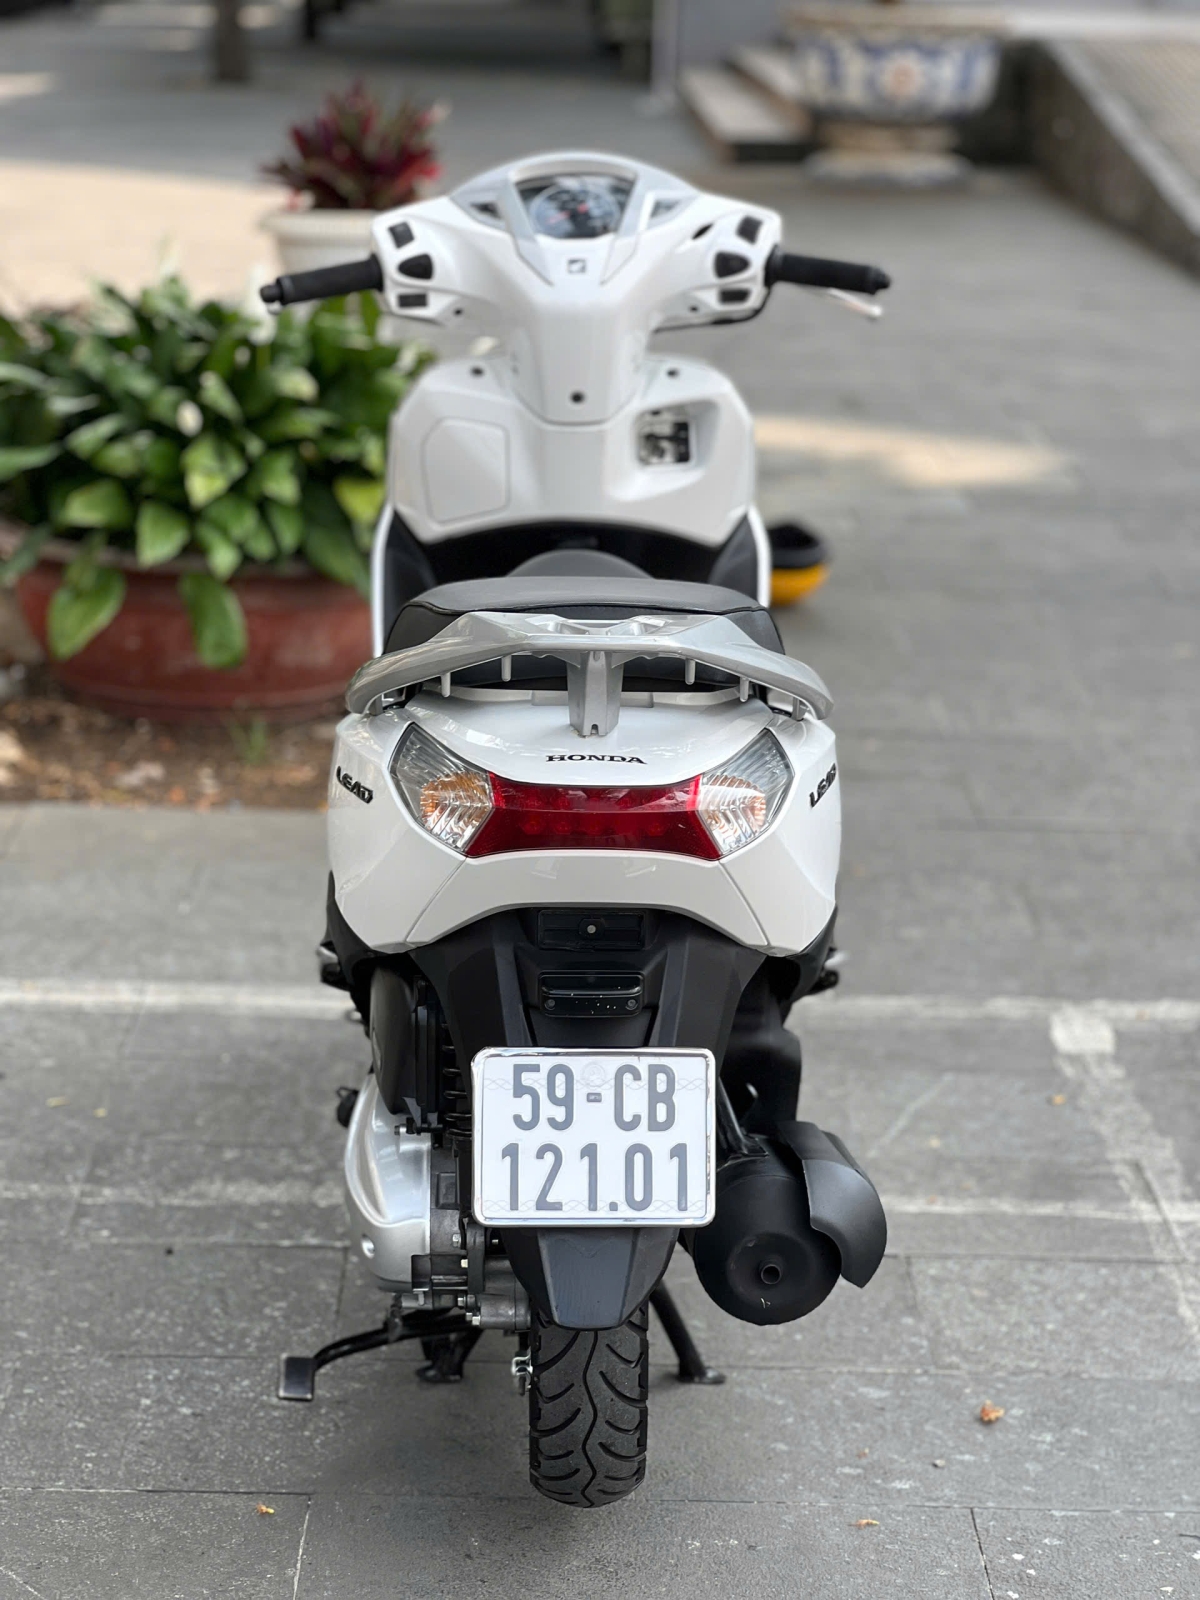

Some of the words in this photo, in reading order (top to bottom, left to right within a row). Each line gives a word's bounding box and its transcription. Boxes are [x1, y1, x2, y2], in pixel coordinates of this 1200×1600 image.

[336, 765, 374, 804] LEAD
[545, 754, 648, 765] HONDA
[513, 1063, 676, 1132] 59-CB
[501, 1142, 689, 1212] 121.01
